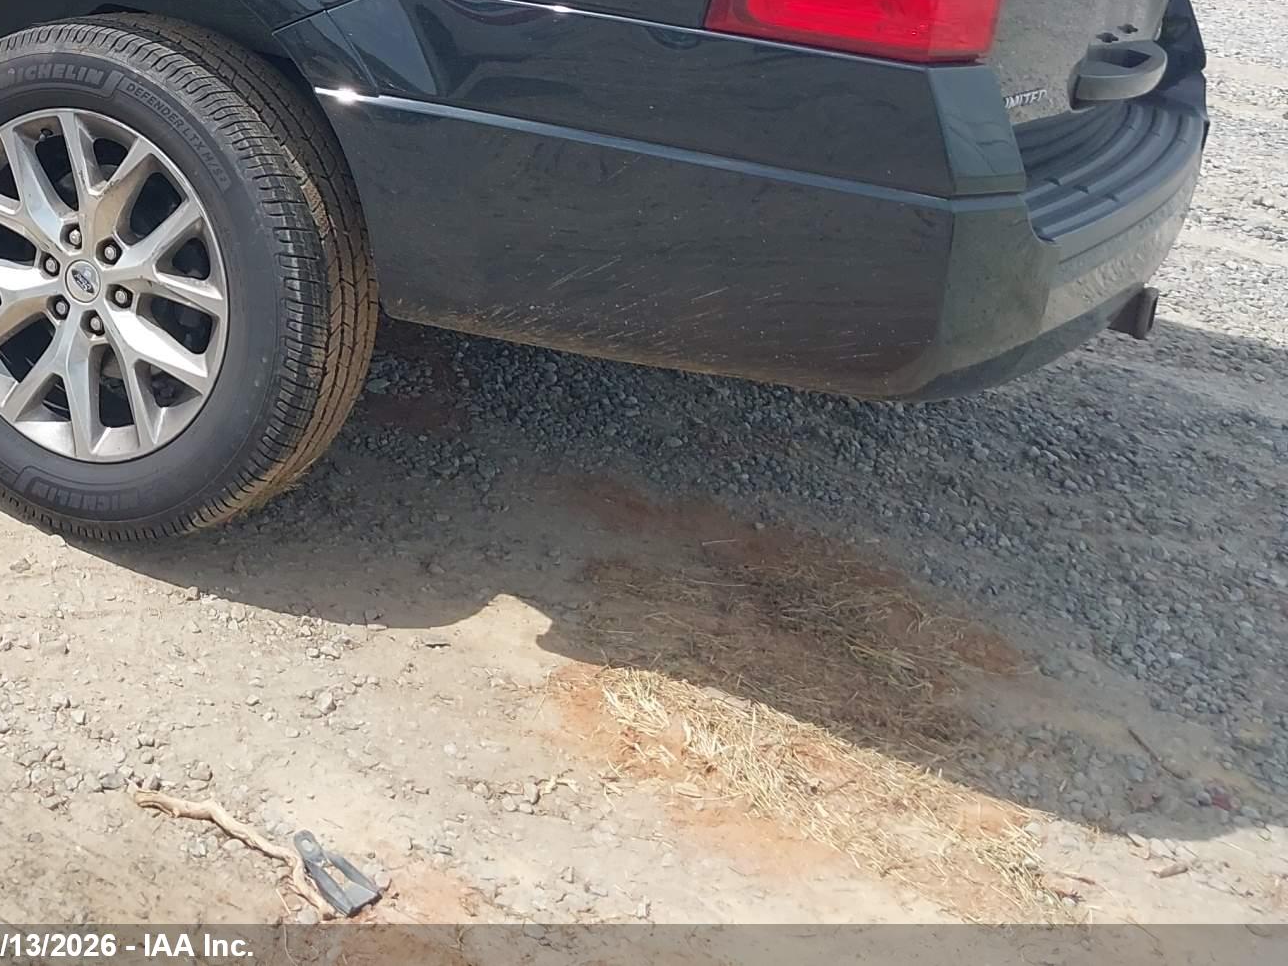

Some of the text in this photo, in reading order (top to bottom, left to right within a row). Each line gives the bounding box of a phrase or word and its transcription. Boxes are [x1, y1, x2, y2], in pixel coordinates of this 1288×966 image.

[0, 63, 104, 89] MICHELIN
[126, 82, 185, 128] DEFENDER
[1004, 89, 1047, 109] IMITED
